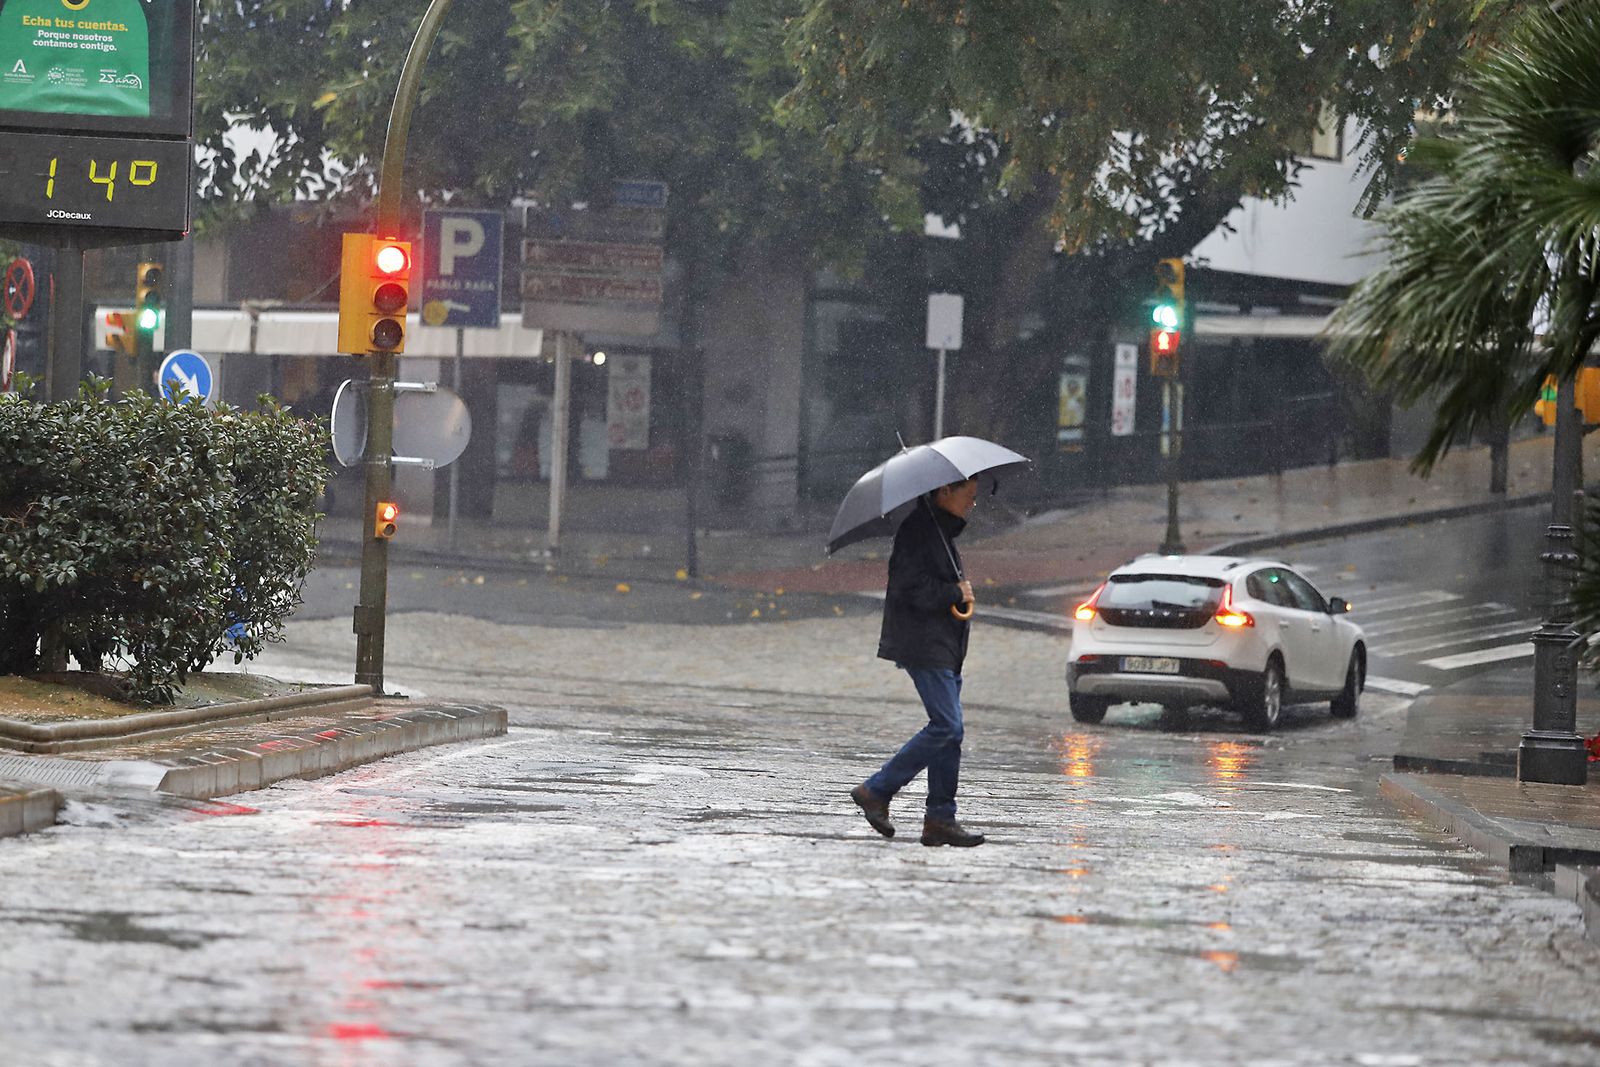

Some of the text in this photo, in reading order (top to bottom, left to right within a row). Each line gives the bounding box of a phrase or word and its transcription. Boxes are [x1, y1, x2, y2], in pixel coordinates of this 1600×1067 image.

[23, 15, 129, 32] Echa tus cuentas.
[38, 29, 113, 42] Porque nosotros
[33, 39, 117, 52] contamos contigo.
[98, 73, 117, 84] 25
[46, 209, 92, 220] JCDecaux
[439, 217, 485, 276] P
